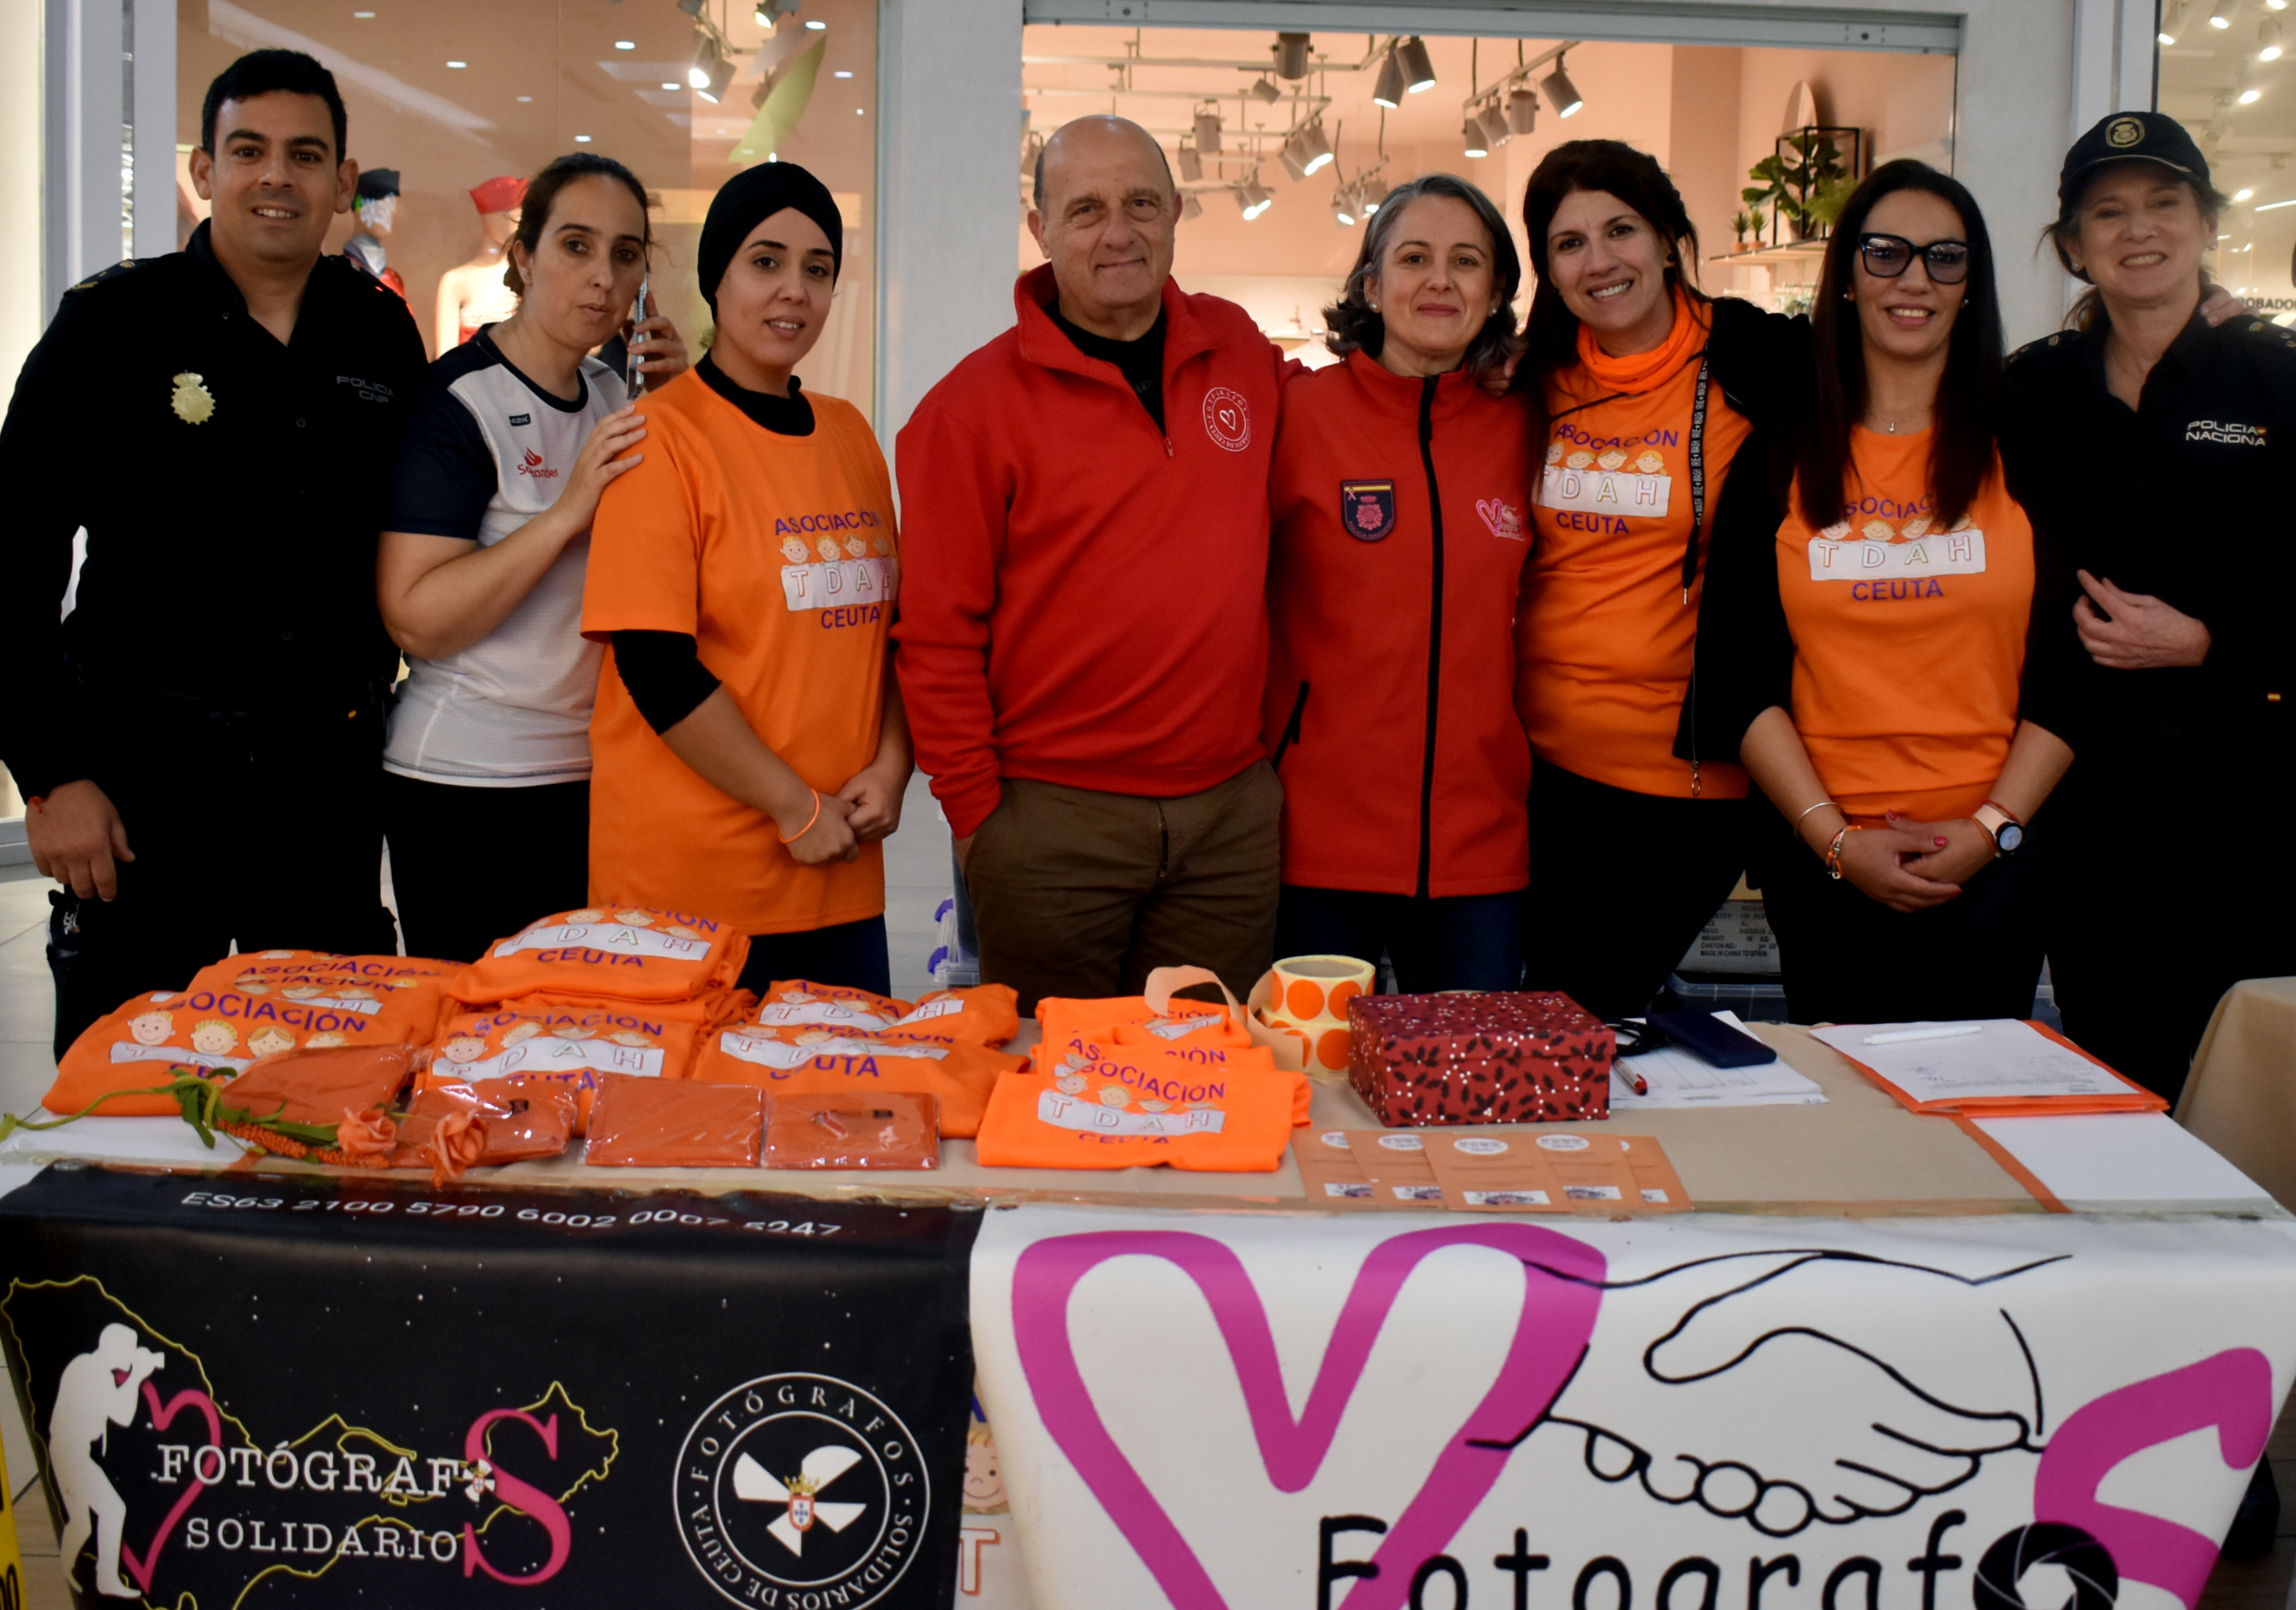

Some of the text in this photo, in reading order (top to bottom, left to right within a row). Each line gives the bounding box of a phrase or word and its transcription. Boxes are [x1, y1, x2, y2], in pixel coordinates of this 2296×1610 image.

[2237, 297, 2296, 310] OBADO
[2186, 431, 2266, 447] NACIONA
[517, 463, 559, 478] Satander
[1544, 470, 1657, 505] DAH
[1846, 493, 1933, 520] SOCIAC
[1556, 512, 1629, 534] CEUTA
[1851, 579, 1944, 601] CEUTA
[821, 605, 880, 630] CEUTA
[538, 946, 644, 968] CEUTA
[156, 992, 367, 1033] SOCIACIÓN
[181, 1192, 283, 1209] ES63
[291, 1200, 395, 1212] 2100
[405, 1201, 506, 1218] 5790
[516, 1208, 617, 1229] 6002
[690, 1384, 914, 1486] FOTÓGRAFOS
[691, 1504, 913, 1610] SOLIDARIOS DE CEUTA
